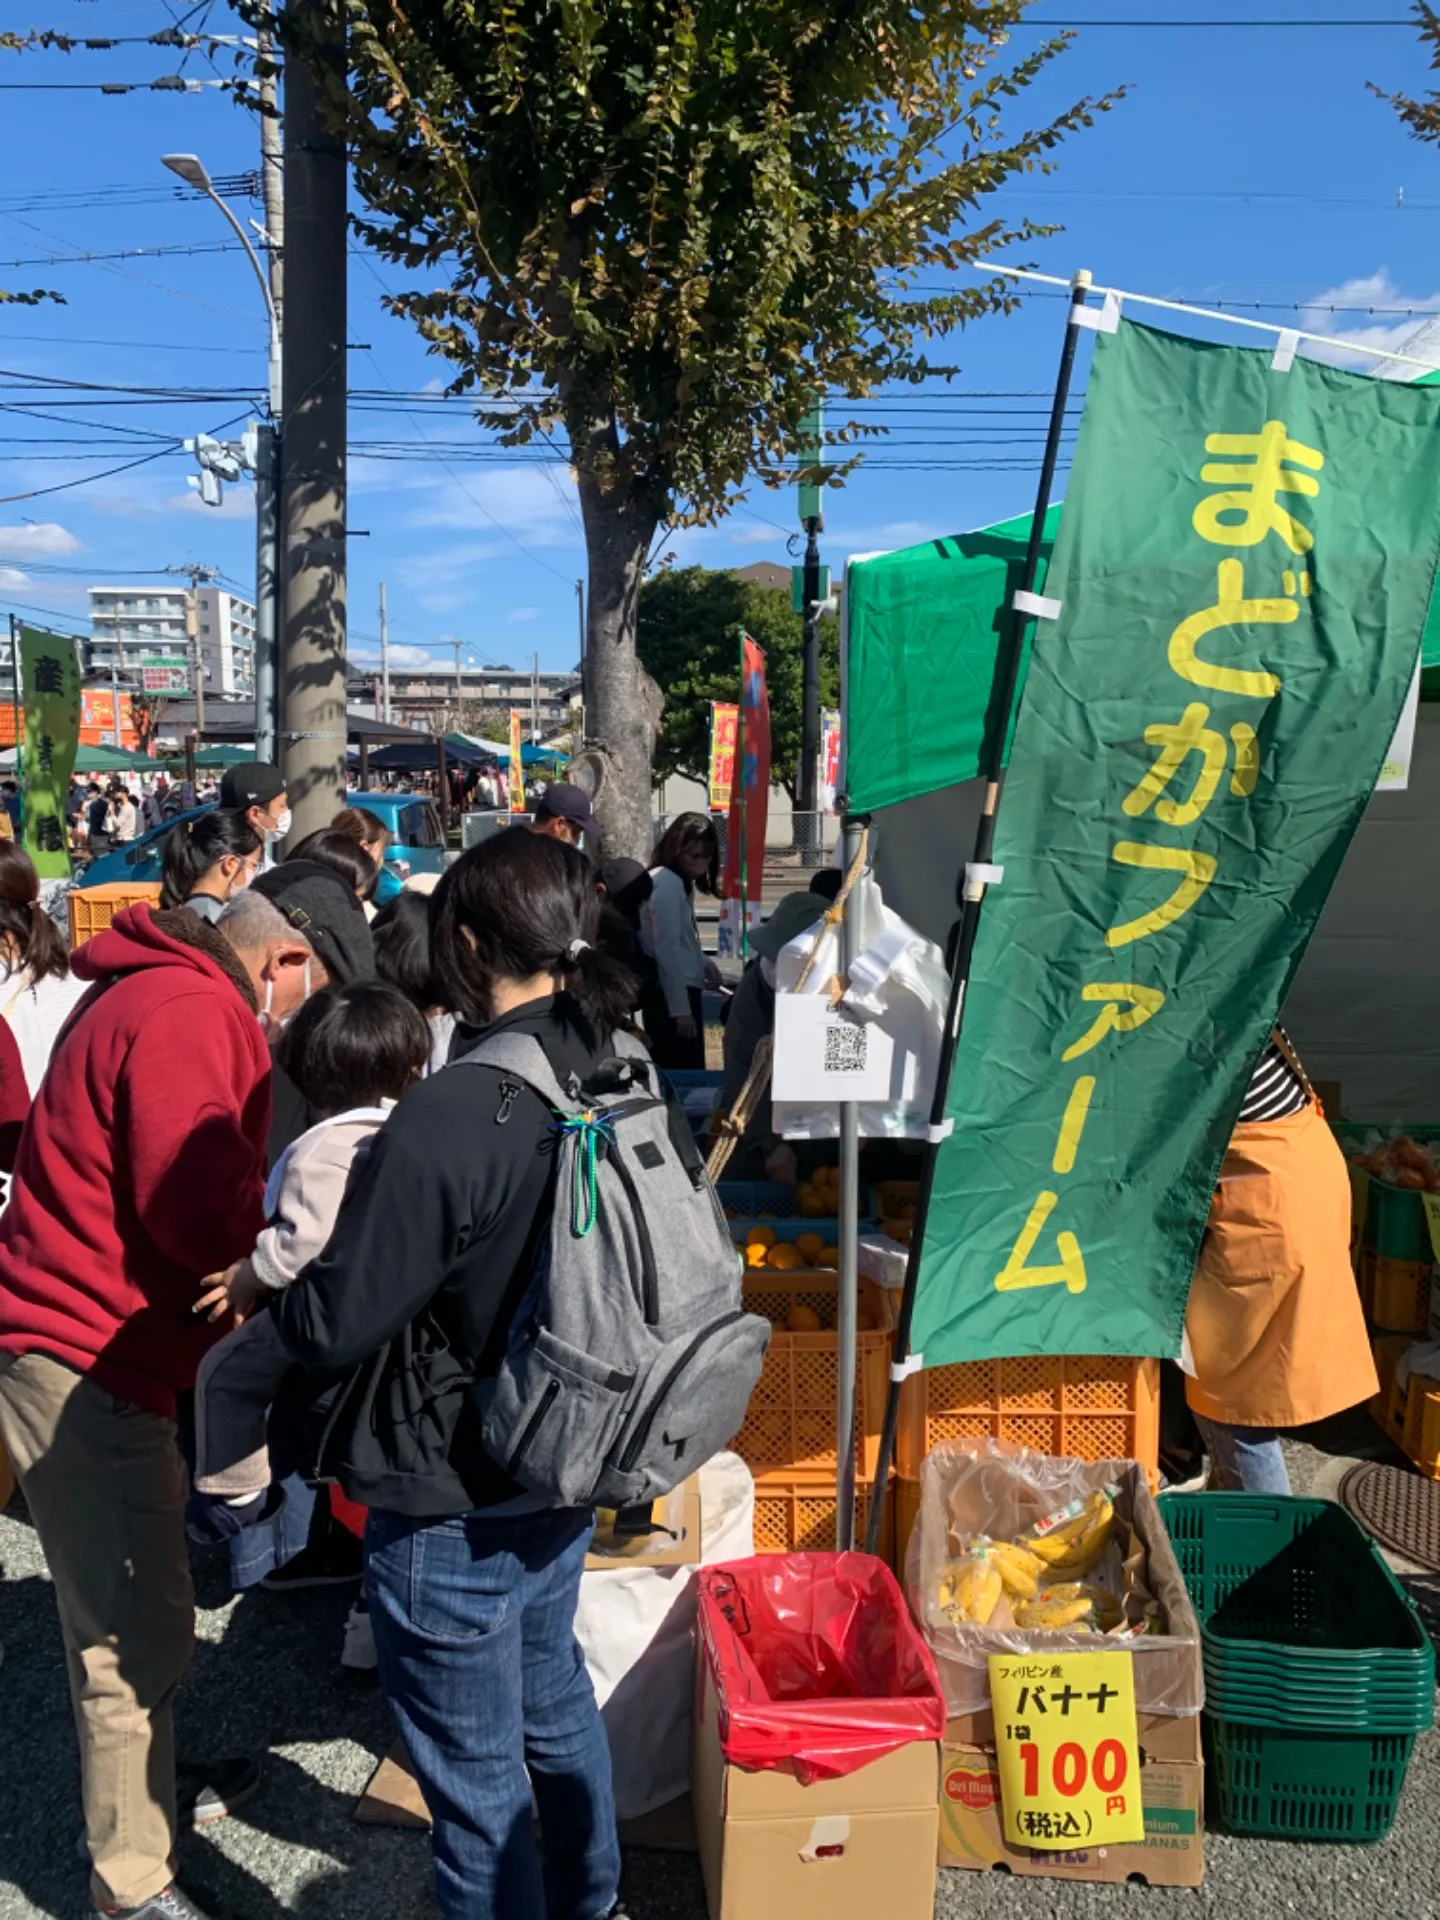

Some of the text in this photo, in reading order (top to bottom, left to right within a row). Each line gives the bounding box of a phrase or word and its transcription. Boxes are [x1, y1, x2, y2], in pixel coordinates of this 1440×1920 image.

[993, 419, 1326, 1295] まどかファーム
[998, 1664, 1064, 1680] フィリピン産
[1015, 1682, 1119, 1717] バナナ
[1005, 1723, 1032, 1741] 1袋
[1015, 1808, 1093, 1839] (税込)
[1144, 1818, 1180, 1832] mium
